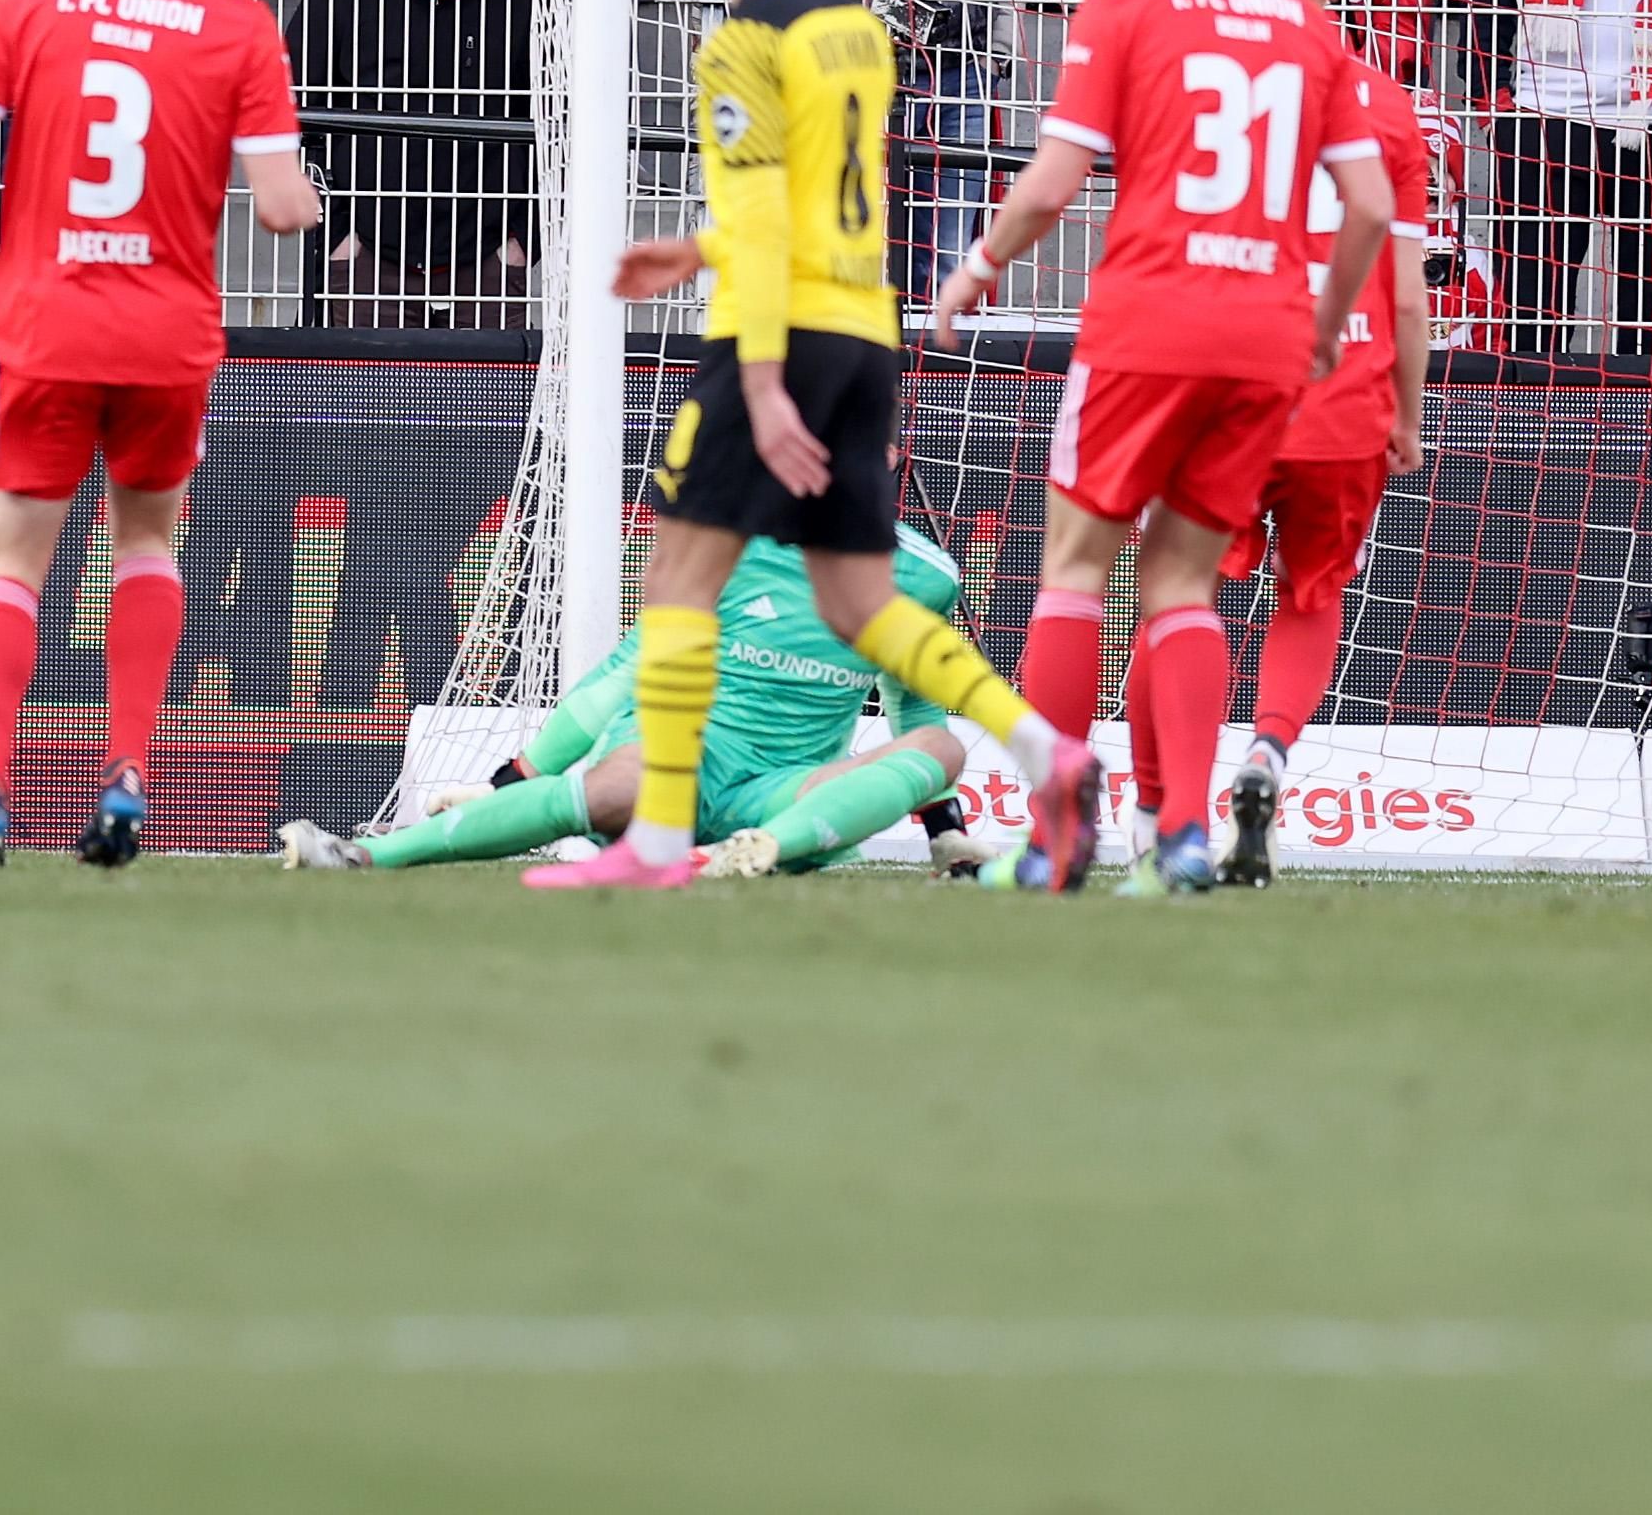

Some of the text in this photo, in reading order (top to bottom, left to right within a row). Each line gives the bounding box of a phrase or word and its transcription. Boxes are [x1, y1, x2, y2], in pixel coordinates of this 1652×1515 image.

[67, 59, 152, 219] 3
[1175, 52, 1304, 222] 31
[729, 640, 876, 692] AROUNDTOWN
